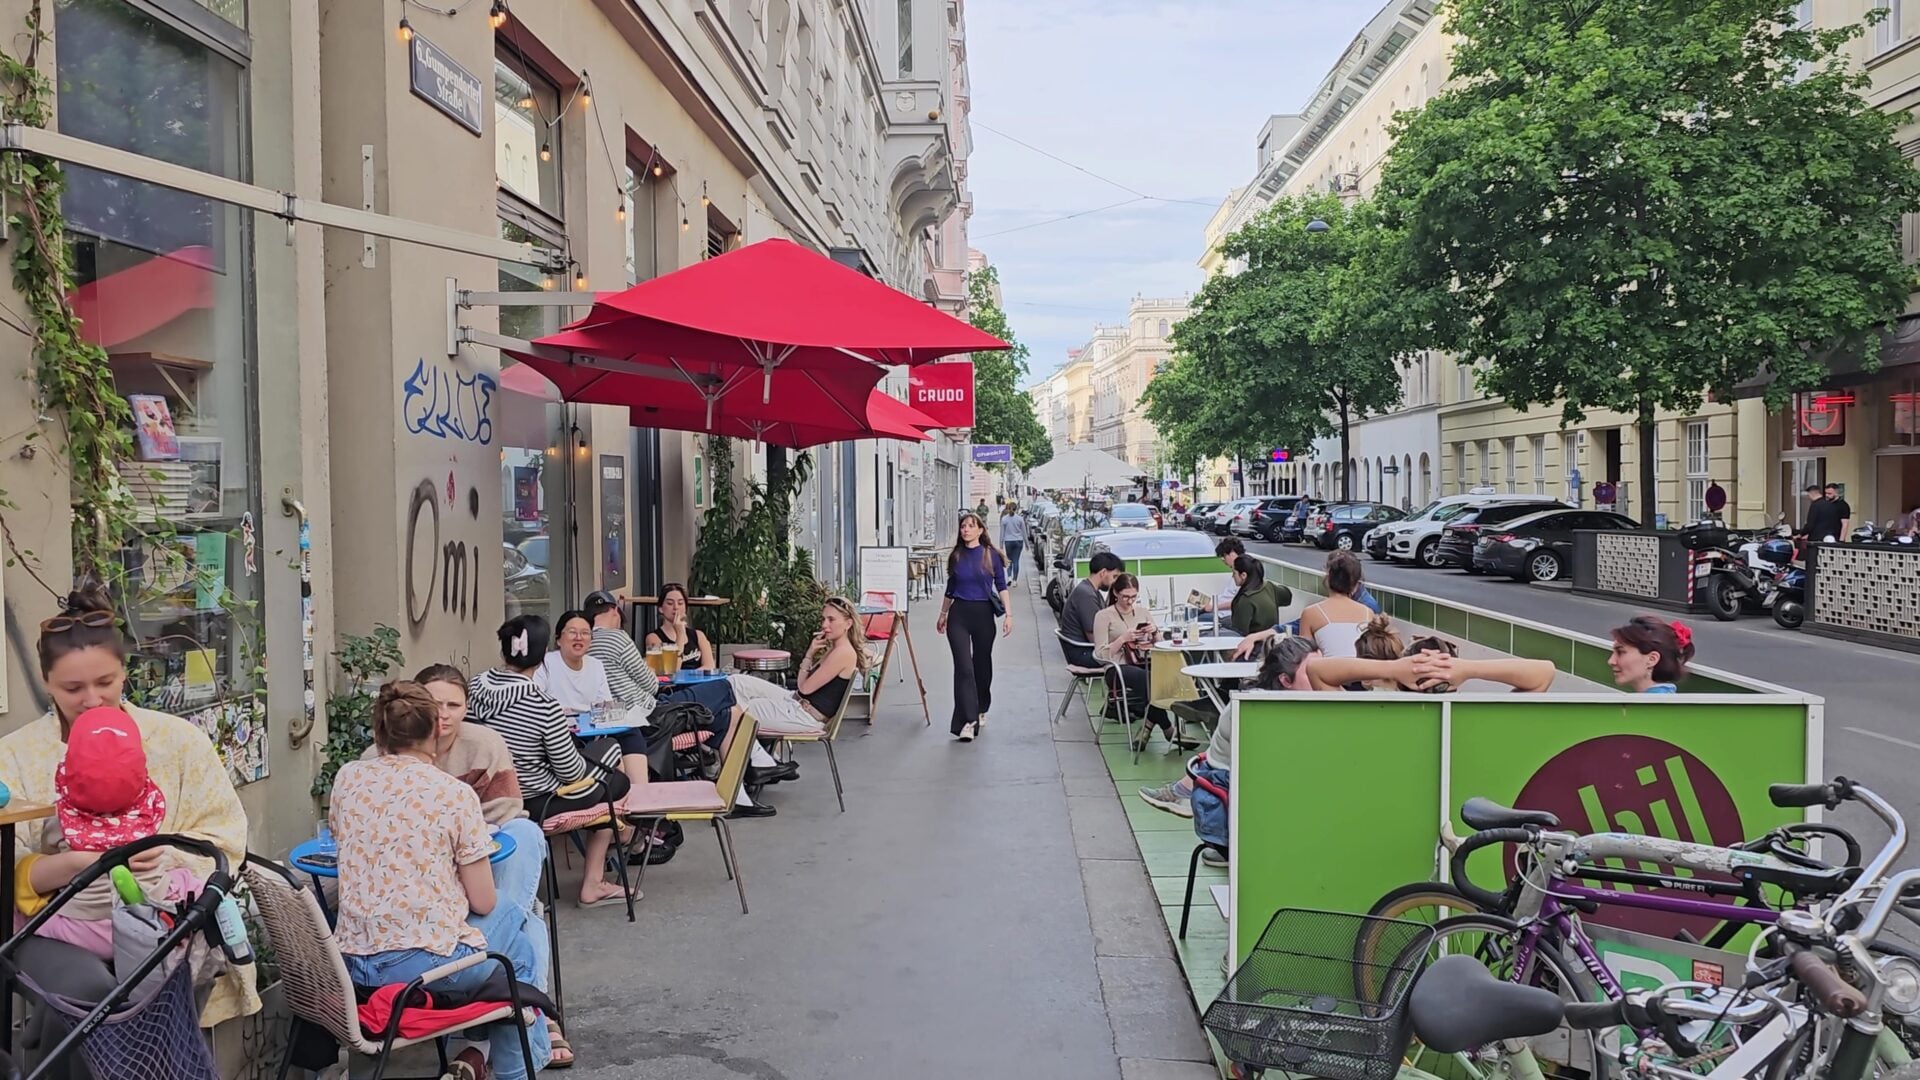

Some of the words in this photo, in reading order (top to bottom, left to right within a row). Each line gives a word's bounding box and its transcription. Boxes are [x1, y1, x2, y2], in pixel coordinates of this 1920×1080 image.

[436, 77, 464, 113] Straße
[918, 388, 965, 402] CRUDO
[1555, 754, 1716, 896] hil
